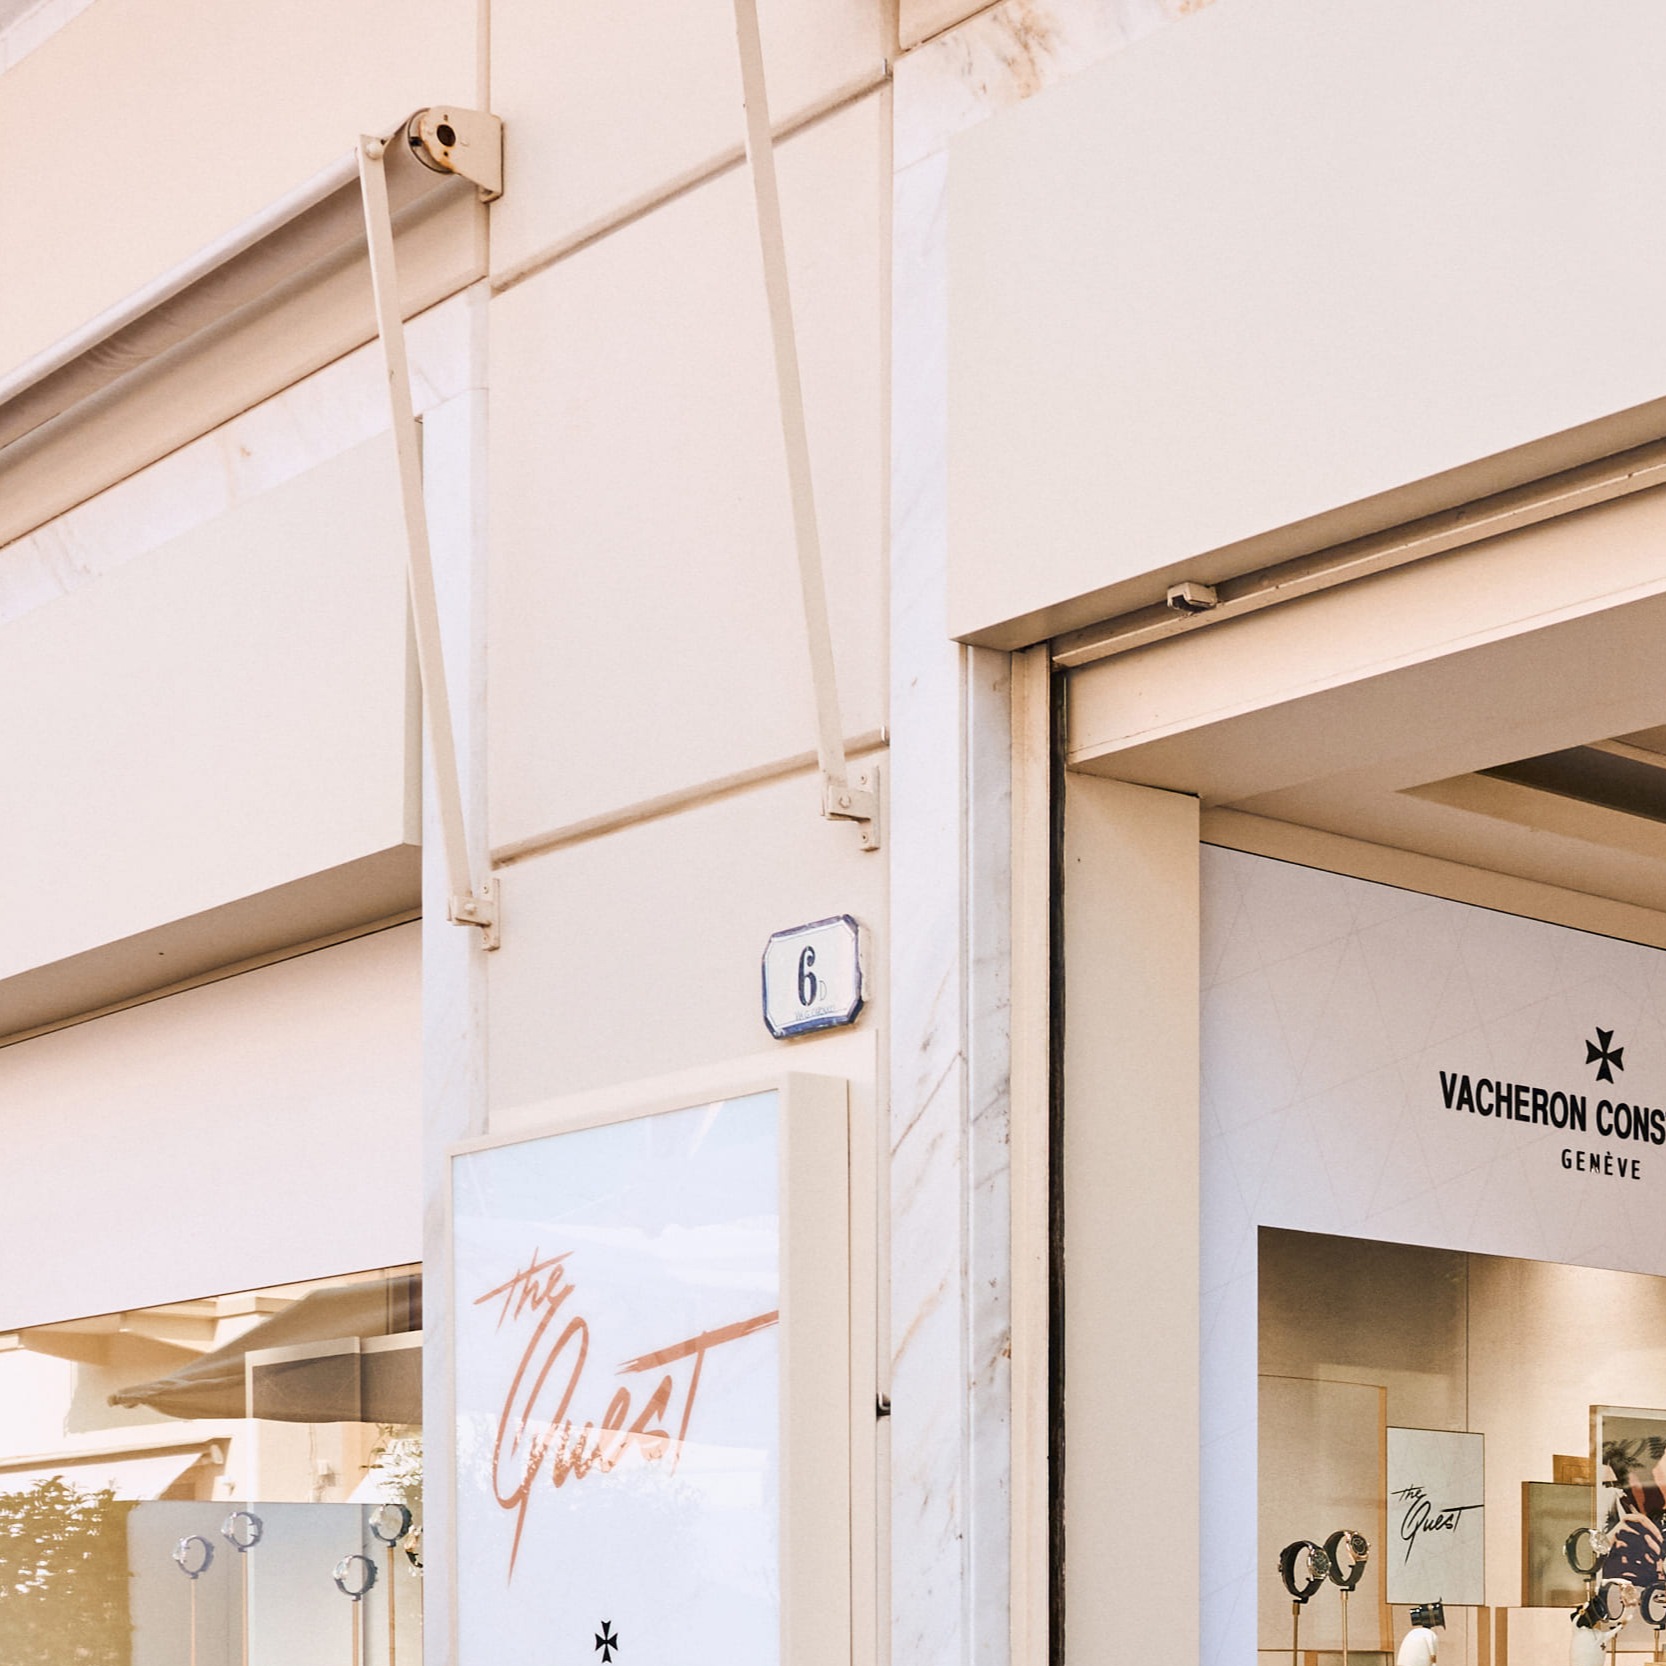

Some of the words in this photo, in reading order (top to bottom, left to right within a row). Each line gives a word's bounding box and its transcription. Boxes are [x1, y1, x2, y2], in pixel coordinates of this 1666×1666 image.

[797, 945, 818, 1007] 6
[1438, 1070, 1587, 1132] VACHERON
[1561, 1148, 1641, 1180] GENÈVE
